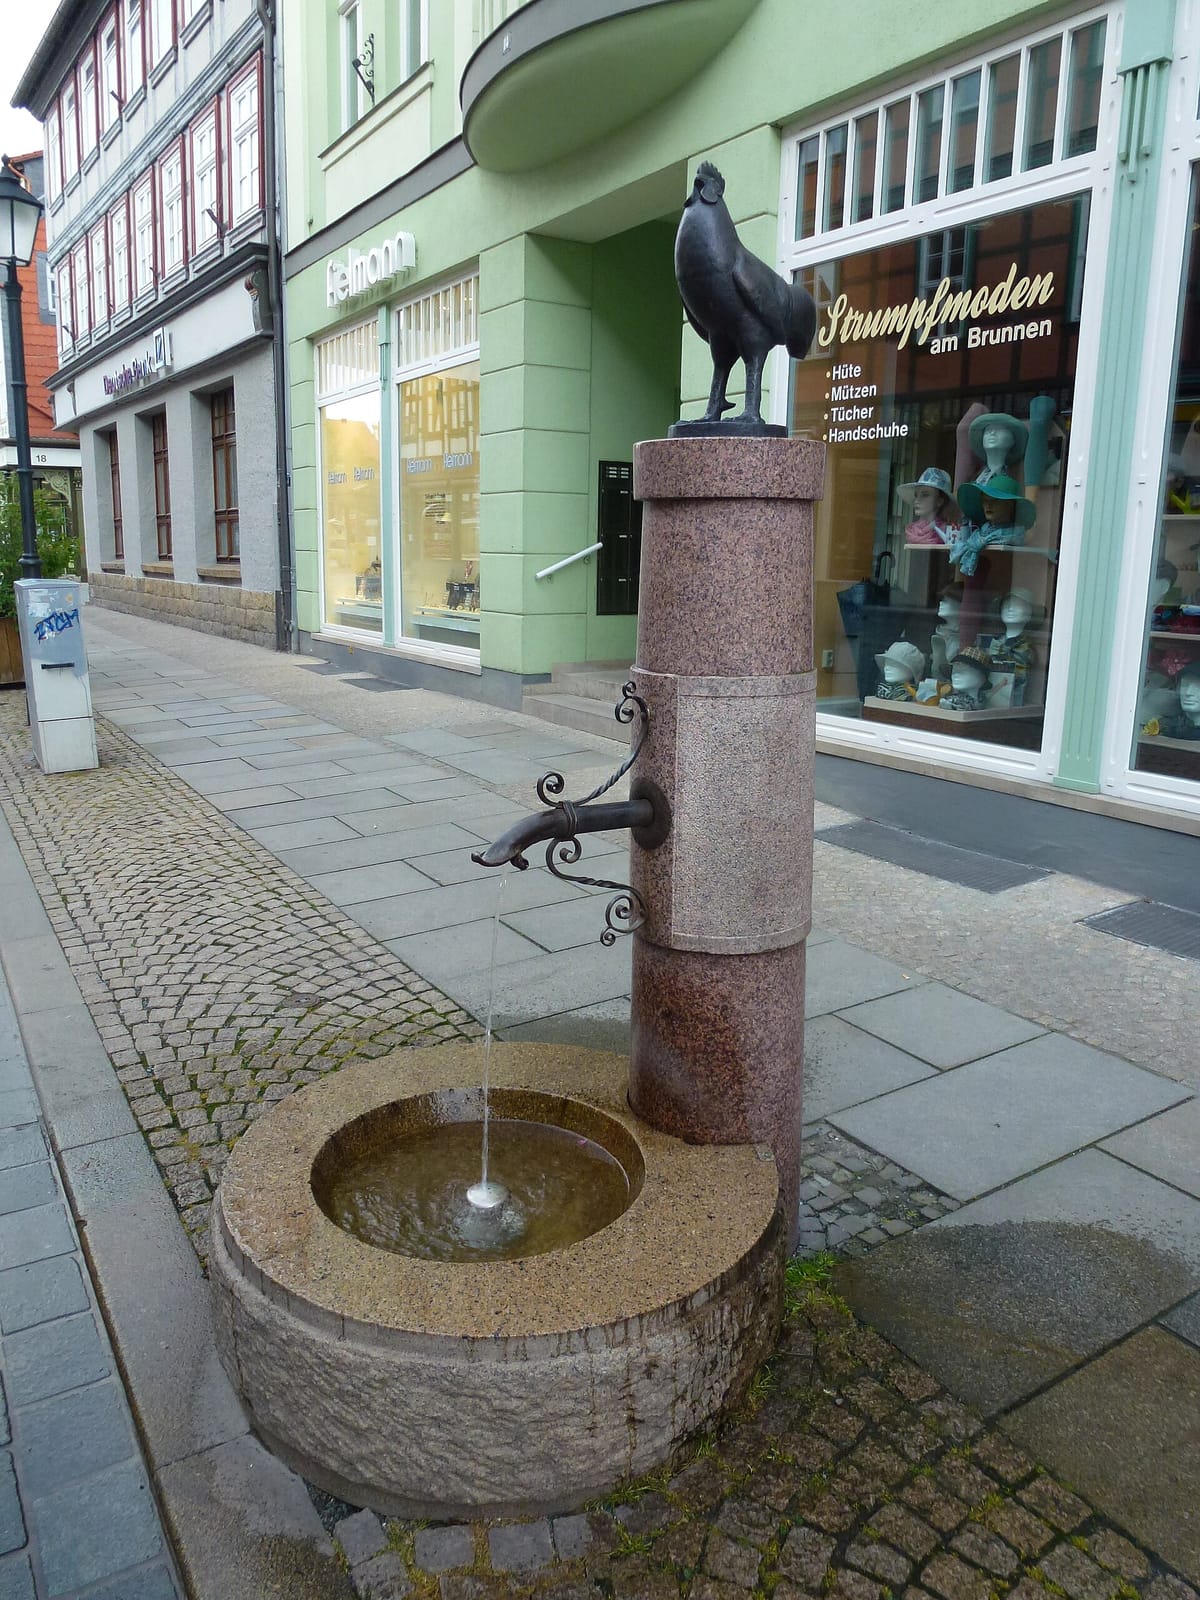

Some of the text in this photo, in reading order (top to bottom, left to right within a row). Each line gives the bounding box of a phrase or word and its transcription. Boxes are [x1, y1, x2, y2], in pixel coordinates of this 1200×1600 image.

[818, 262, 1055, 350] Strumpfmoden
[930, 318, 1052, 355] am Brunnen
[832, 363, 862, 381] Hüte
[831, 383, 877, 402] Mützen
[831, 405, 874, 422] Tücher
[828, 422, 909, 443] Handschuhe
[36, 454, 46, 463] 18
